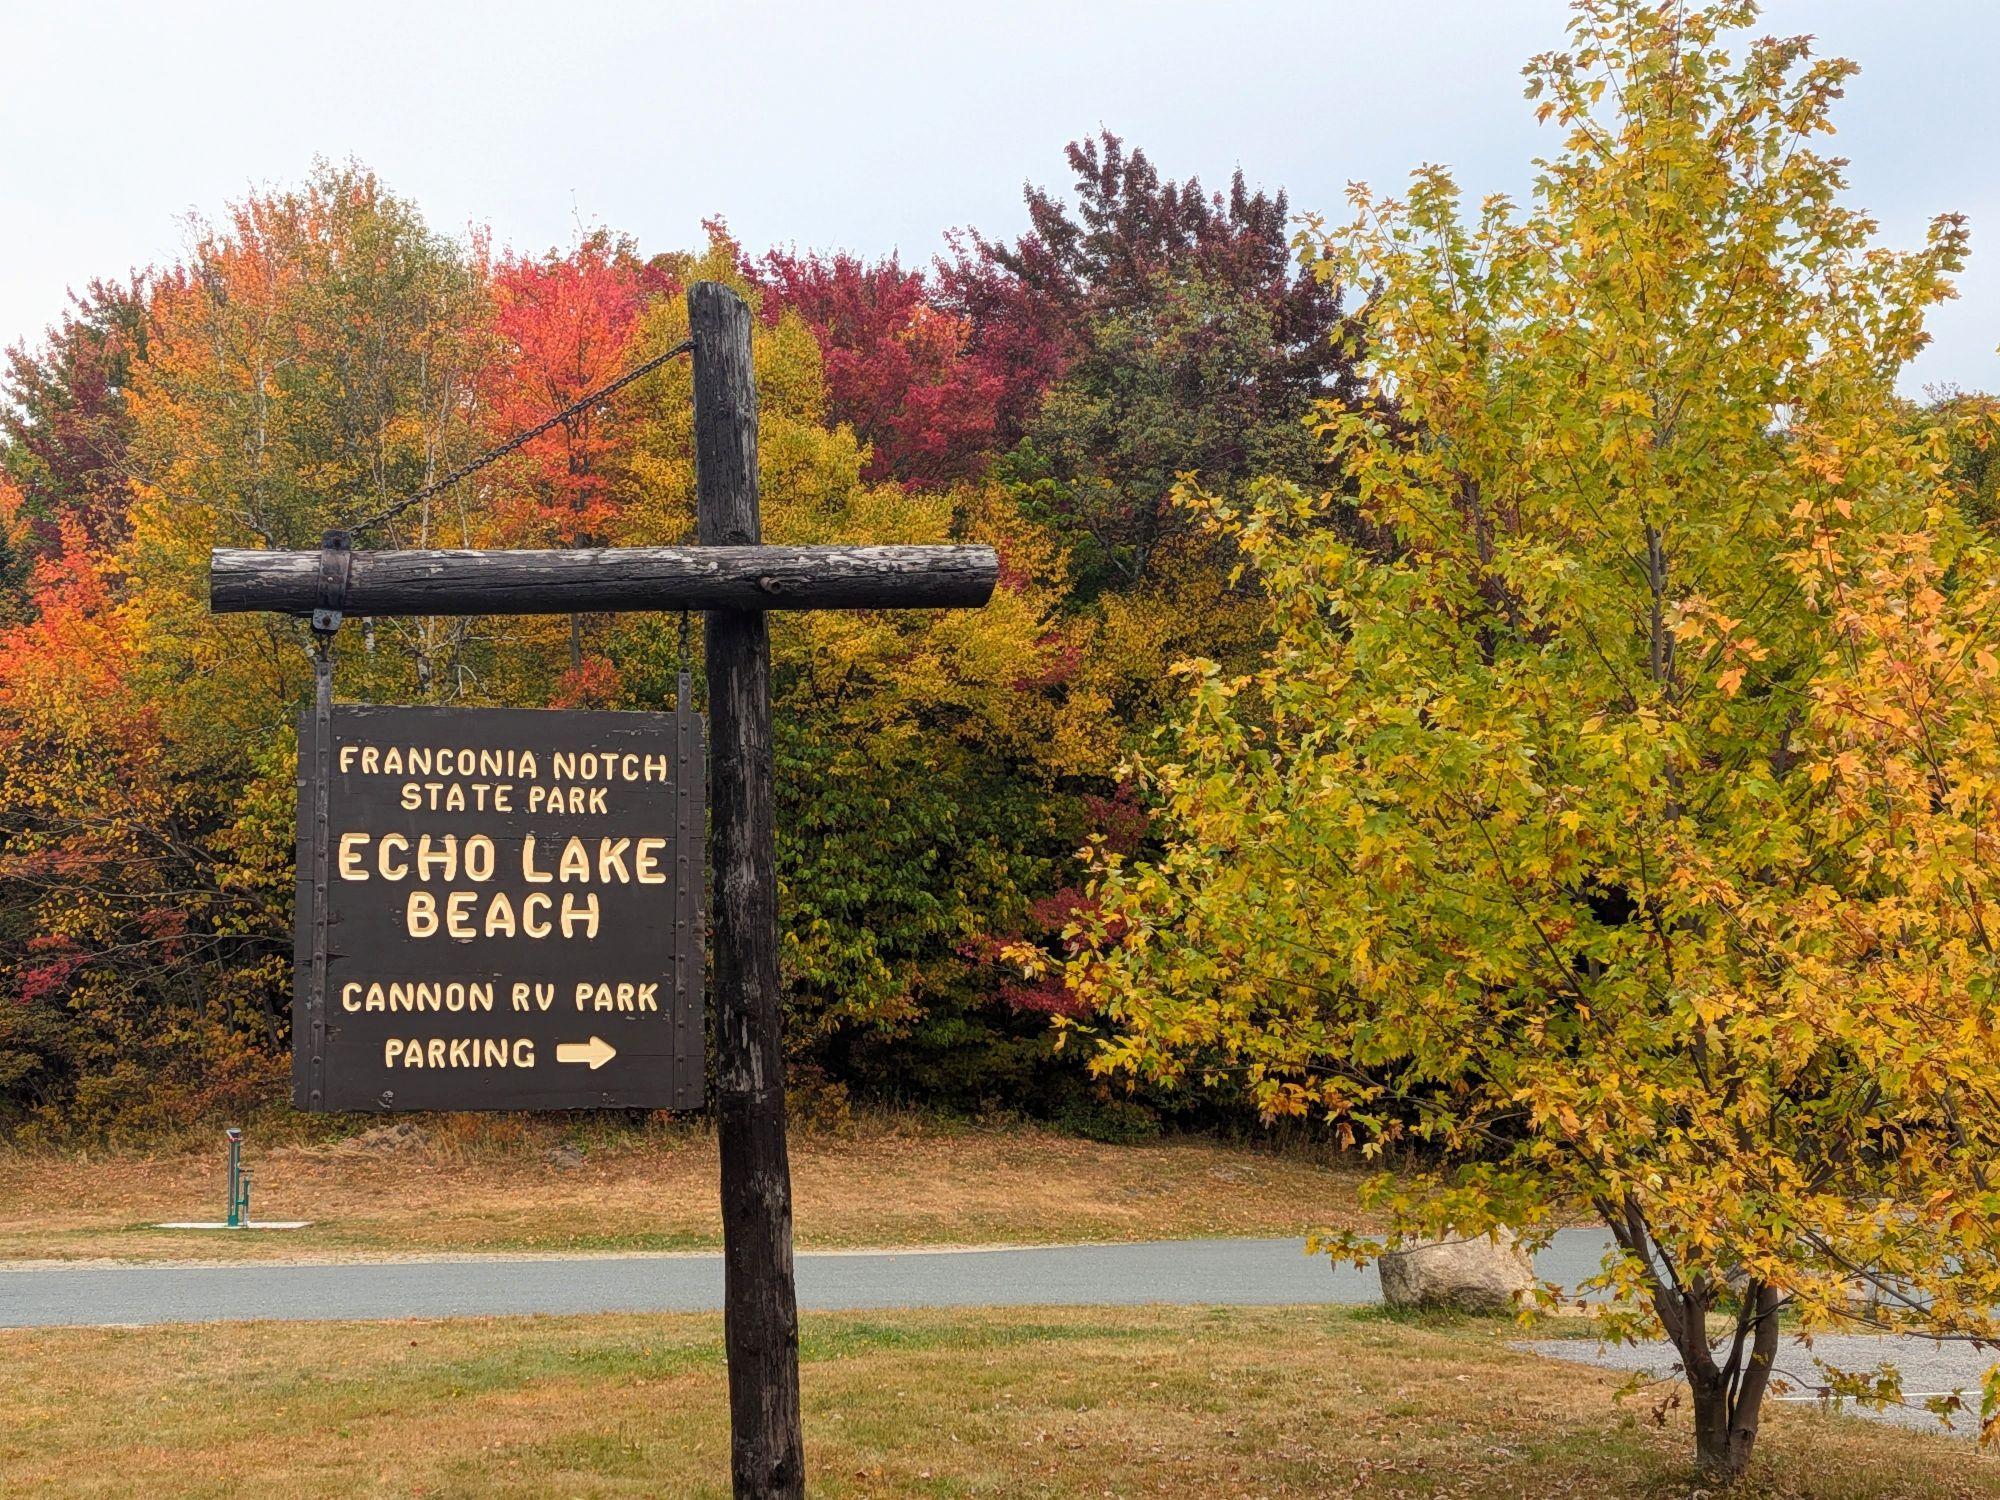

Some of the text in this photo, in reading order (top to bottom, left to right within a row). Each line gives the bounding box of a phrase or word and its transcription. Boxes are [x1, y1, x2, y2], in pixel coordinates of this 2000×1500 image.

[339, 745, 668, 783] FRANCONIA NOTCH
[400, 782, 609, 815] STATE PARK
[337, 832, 668, 885] ECHO LAKE
[406, 891, 601, 939] BEACH
[341, 982, 660, 1013] CANNON RV PARK
[384, 1037, 536, 1069] PARKING
